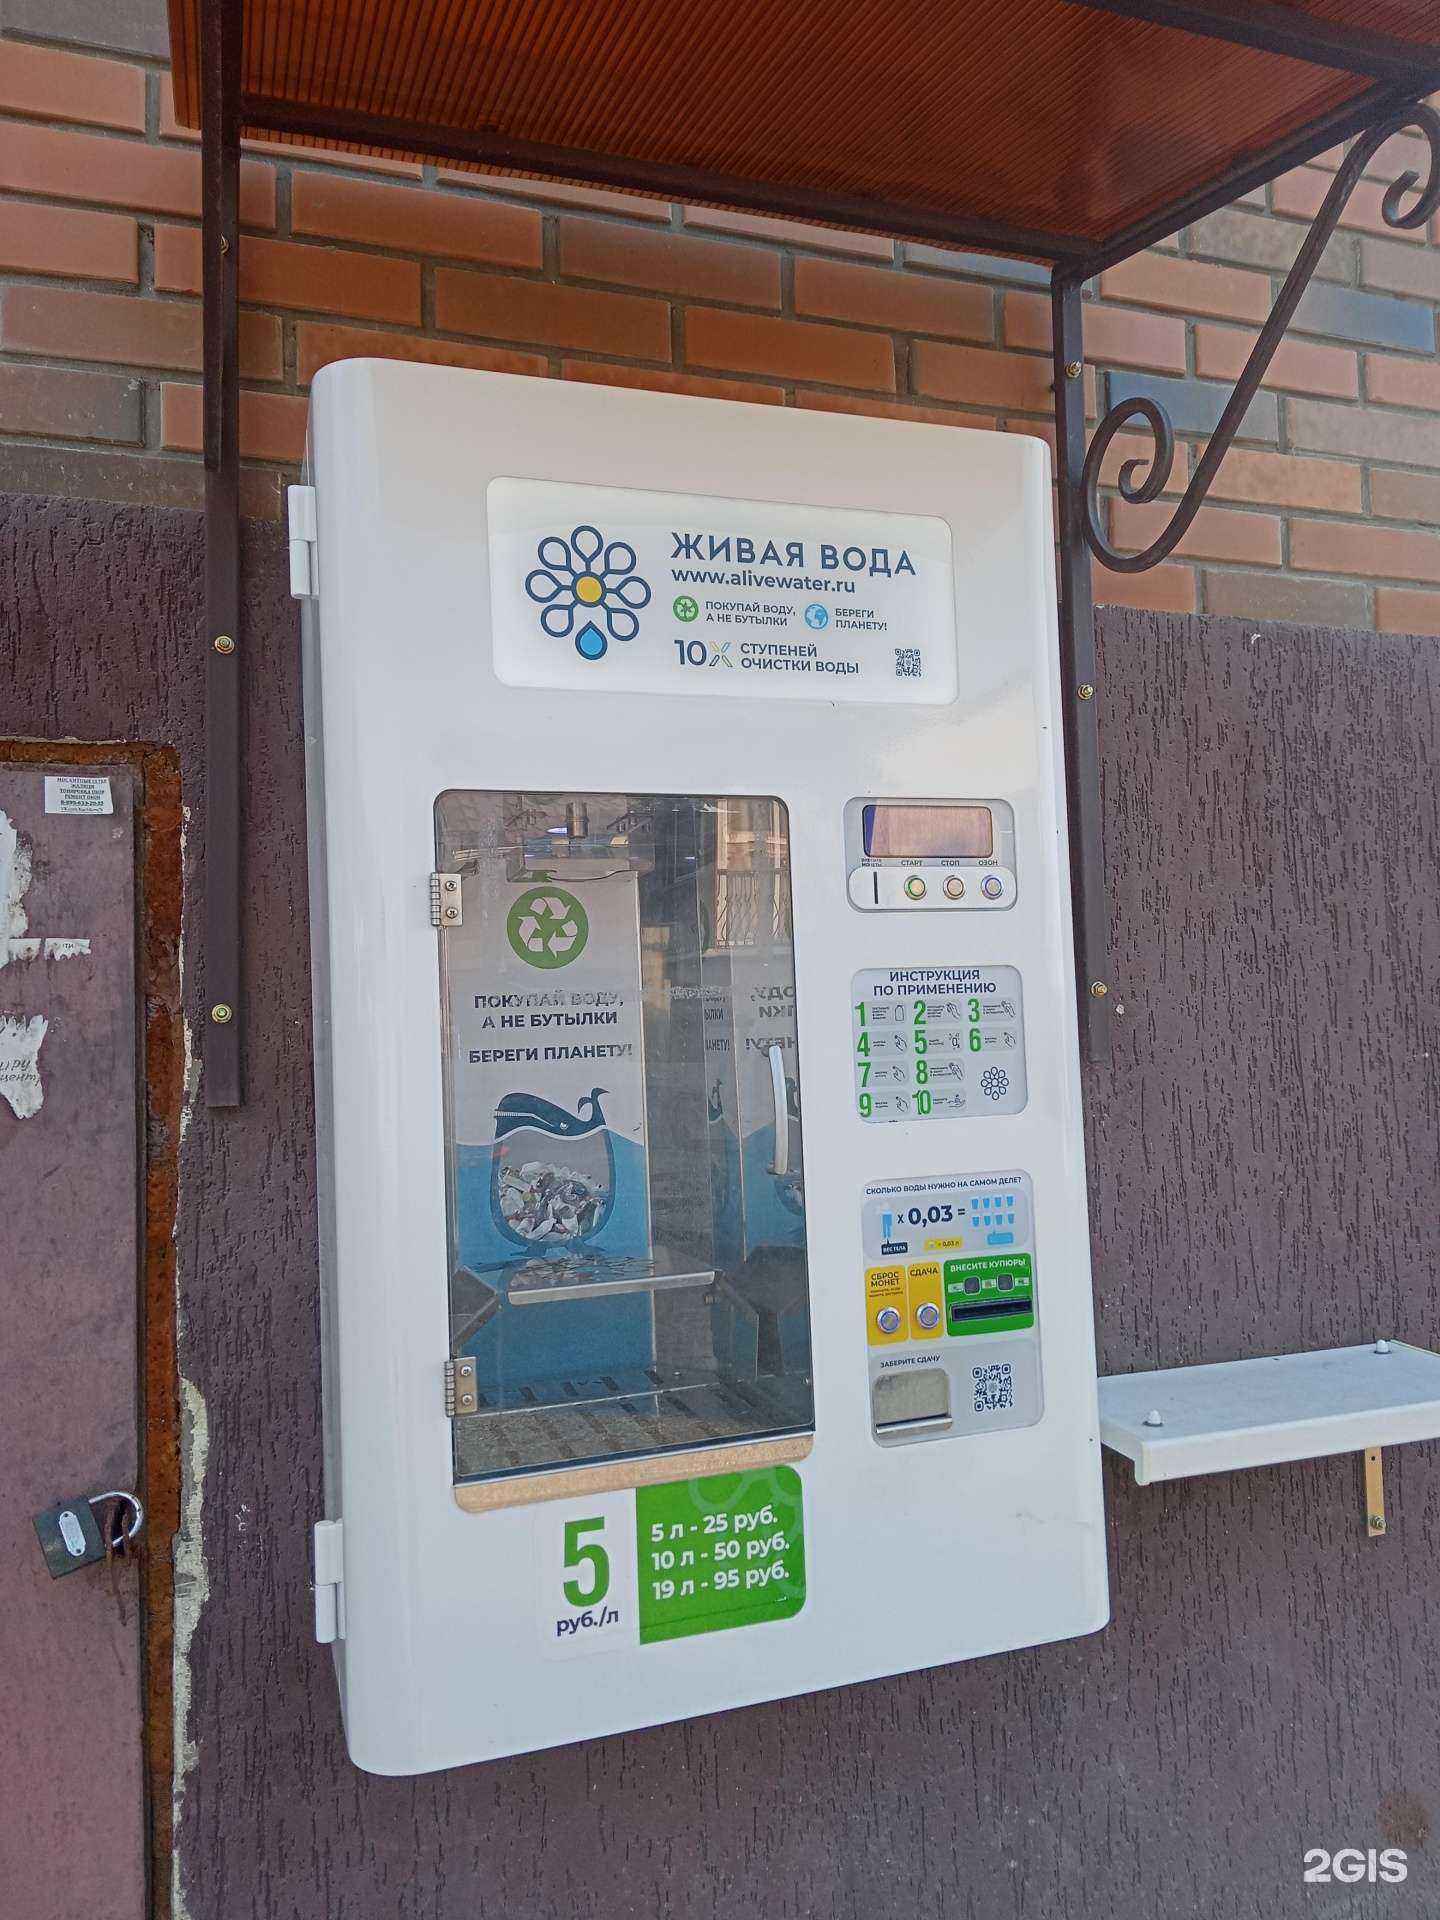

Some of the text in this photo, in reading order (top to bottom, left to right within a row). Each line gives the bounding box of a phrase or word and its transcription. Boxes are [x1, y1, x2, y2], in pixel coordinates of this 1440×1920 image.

[671, 532, 916, 578] ЖИВАЯ ВОДА
[672, 569, 855, 593] www.alivewater.ru
[705, 600, 796, 616] ПОКУПАЙ ВОДУ,
[835, 608, 875, 619] БЕРЕГИ
[717, 615, 732, 623] НЕ
[735, 615, 788, 626] БУТЫЛКИ
[835, 620, 887, 631] ПЛАНЕТУ!
[740, 642, 818, 658] СТУПЕНЕЙ
[741, 658, 860, 675] ОЧИСТКИ ВОДЫ
[889, 969, 980, 982] ИНСТРУКЦИЯ
[474, 990, 624, 1009] ПОКУПАЙ ВОДУ,
[873, 983, 996, 996] ПО ПРИМЕНЕНИЮ
[482, 1011, 618, 1029] А НЕ БУТЫЛКИ
[855, 1001, 866, 1027] 1
[913, 1000, 927, 1025] 2
[967, 998, 980, 1023] 3
[856, 1031, 871, 1057] 4
[914, 1029, 928, 1055] 5
[969, 1028, 982, 1052] 6
[469, 1043, 633, 1063] БЕРЕГИ ПЛАНЕТУ!
[857, 1062, 872, 1088] 7
[915, 1060, 928, 1085] 8
[859, 1092, 872, 1118] 9
[912, 1089, 932, 1116] 10
[866, 1176, 1022, 1195] СКОЛЬКО ВОДЫ НУЖНО НА САМОМ ДЕЛЕ?
[907, 1205, 953, 1228] 0,03
[870, 1271, 900, 1281] СБРОС
[910, 1267, 939, 1277] СДАЧА
[950, 1258, 1026, 1273] ВНЕСИТЕ КУПЮРЫ
[870, 1279, 900, 1288] МОНЕТ
[880, 1355, 941, 1368] ЗАБЕРИТЕ СДАЧУ
[651, 1522, 664, 1543] 5
[669, 1523, 684, 1540] л
[703, 1512, 728, 1535] 25
[734, 1504, 778, 1534] руб.
[563, 1516, 610, 1608] 5
[651, 1550, 675, 1571] 10
[680, 1550, 694, 1567] л
[714, 1540, 740, 1562] 50
[746, 1531, 790, 1561] руб.
[652, 1580, 675, 1600] 19
[680, 1580, 694, 1597] л
[714, 1568, 740, 1591] 95
[746, 1560, 790, 1589] руб.
[556, 1606, 619, 1637] руб./л
